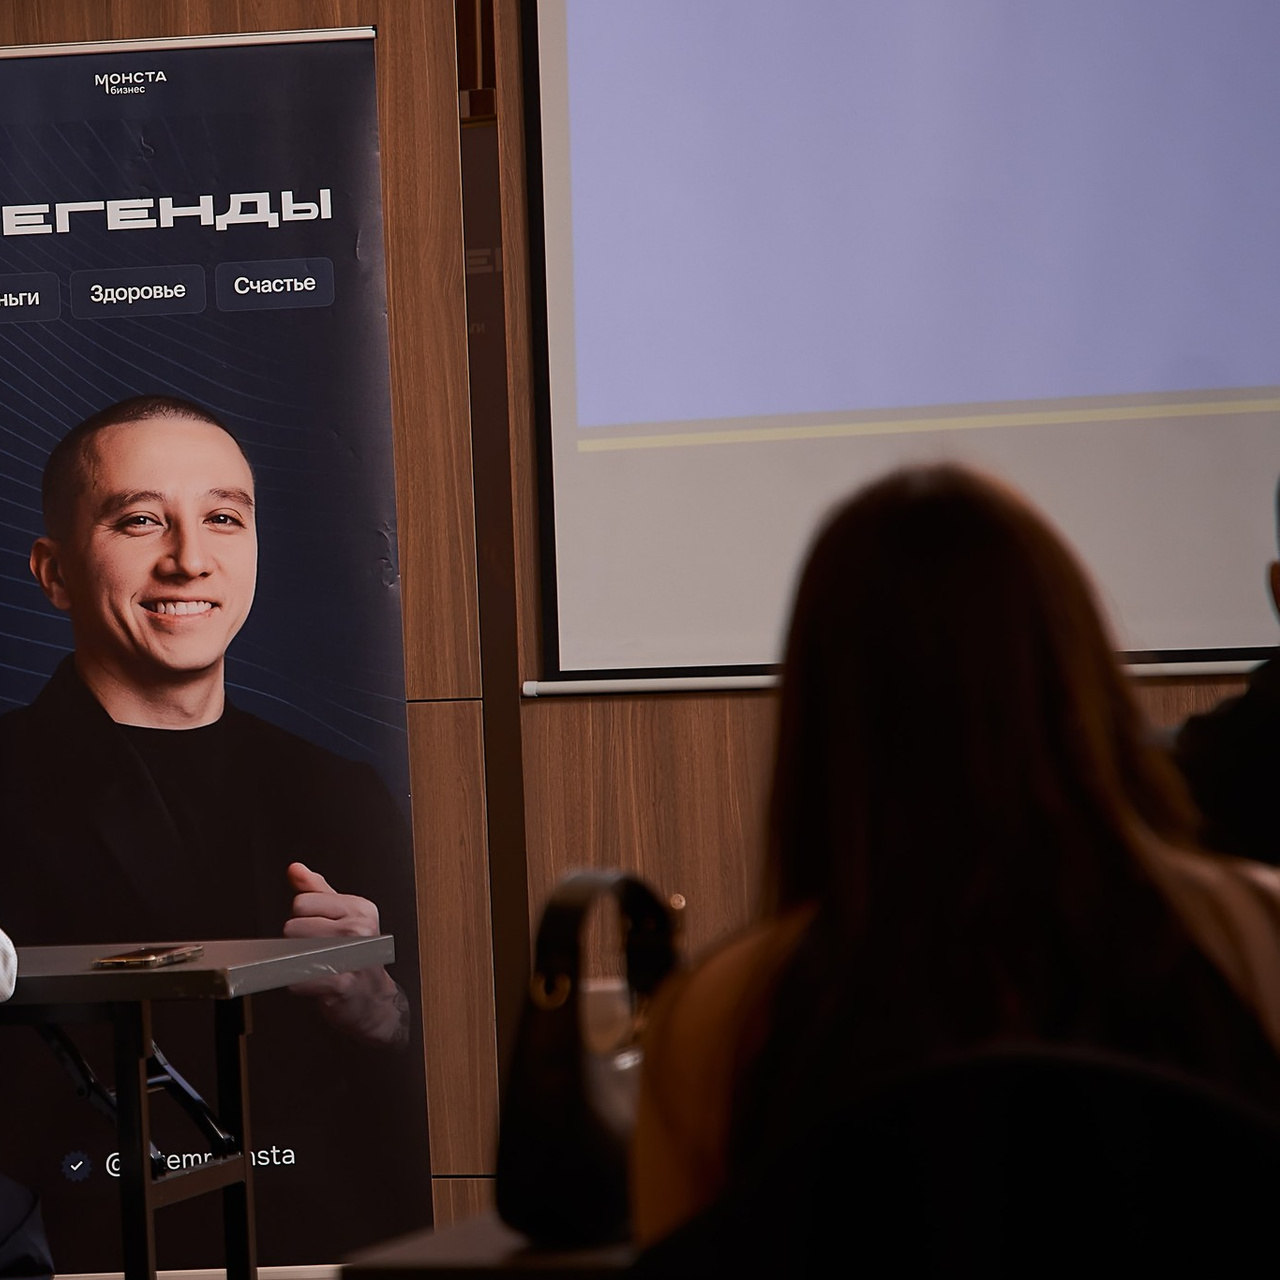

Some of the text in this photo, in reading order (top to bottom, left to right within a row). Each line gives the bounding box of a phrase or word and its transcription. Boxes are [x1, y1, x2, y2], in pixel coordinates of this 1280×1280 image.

[94, 70, 167, 94] МОНСТА
[110, 85, 146, 95] бизнес
[90, 282, 186, 305] Здоровье
[233, 275, 317, 297] Счастье
